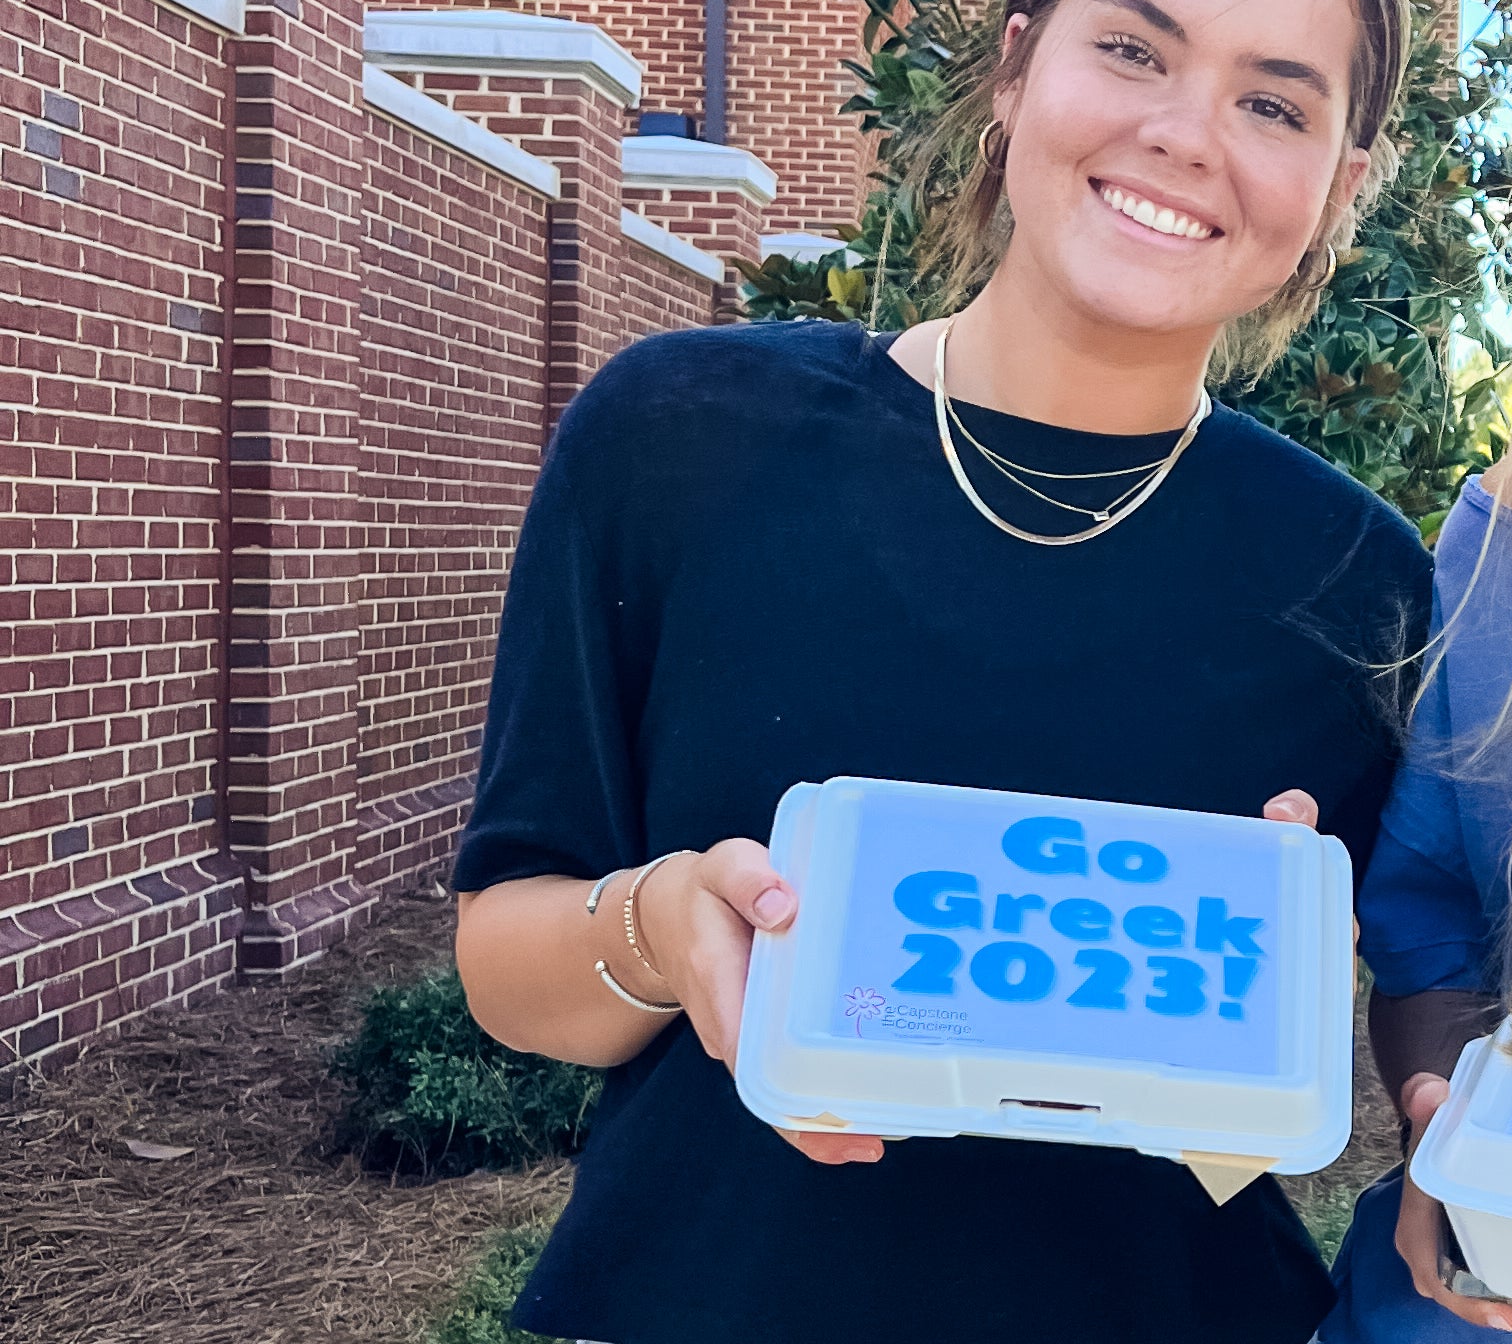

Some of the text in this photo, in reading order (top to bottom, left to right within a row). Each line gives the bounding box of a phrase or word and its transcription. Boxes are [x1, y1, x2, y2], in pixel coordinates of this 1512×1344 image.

[1000, 815, 1169, 884] Go
[892, 869, 1265, 959] Greek
[890, 933, 1264, 1022] 2023!
[895, 1018, 972, 1035] Concierge
[897, 1004, 969, 1021] Capstone
